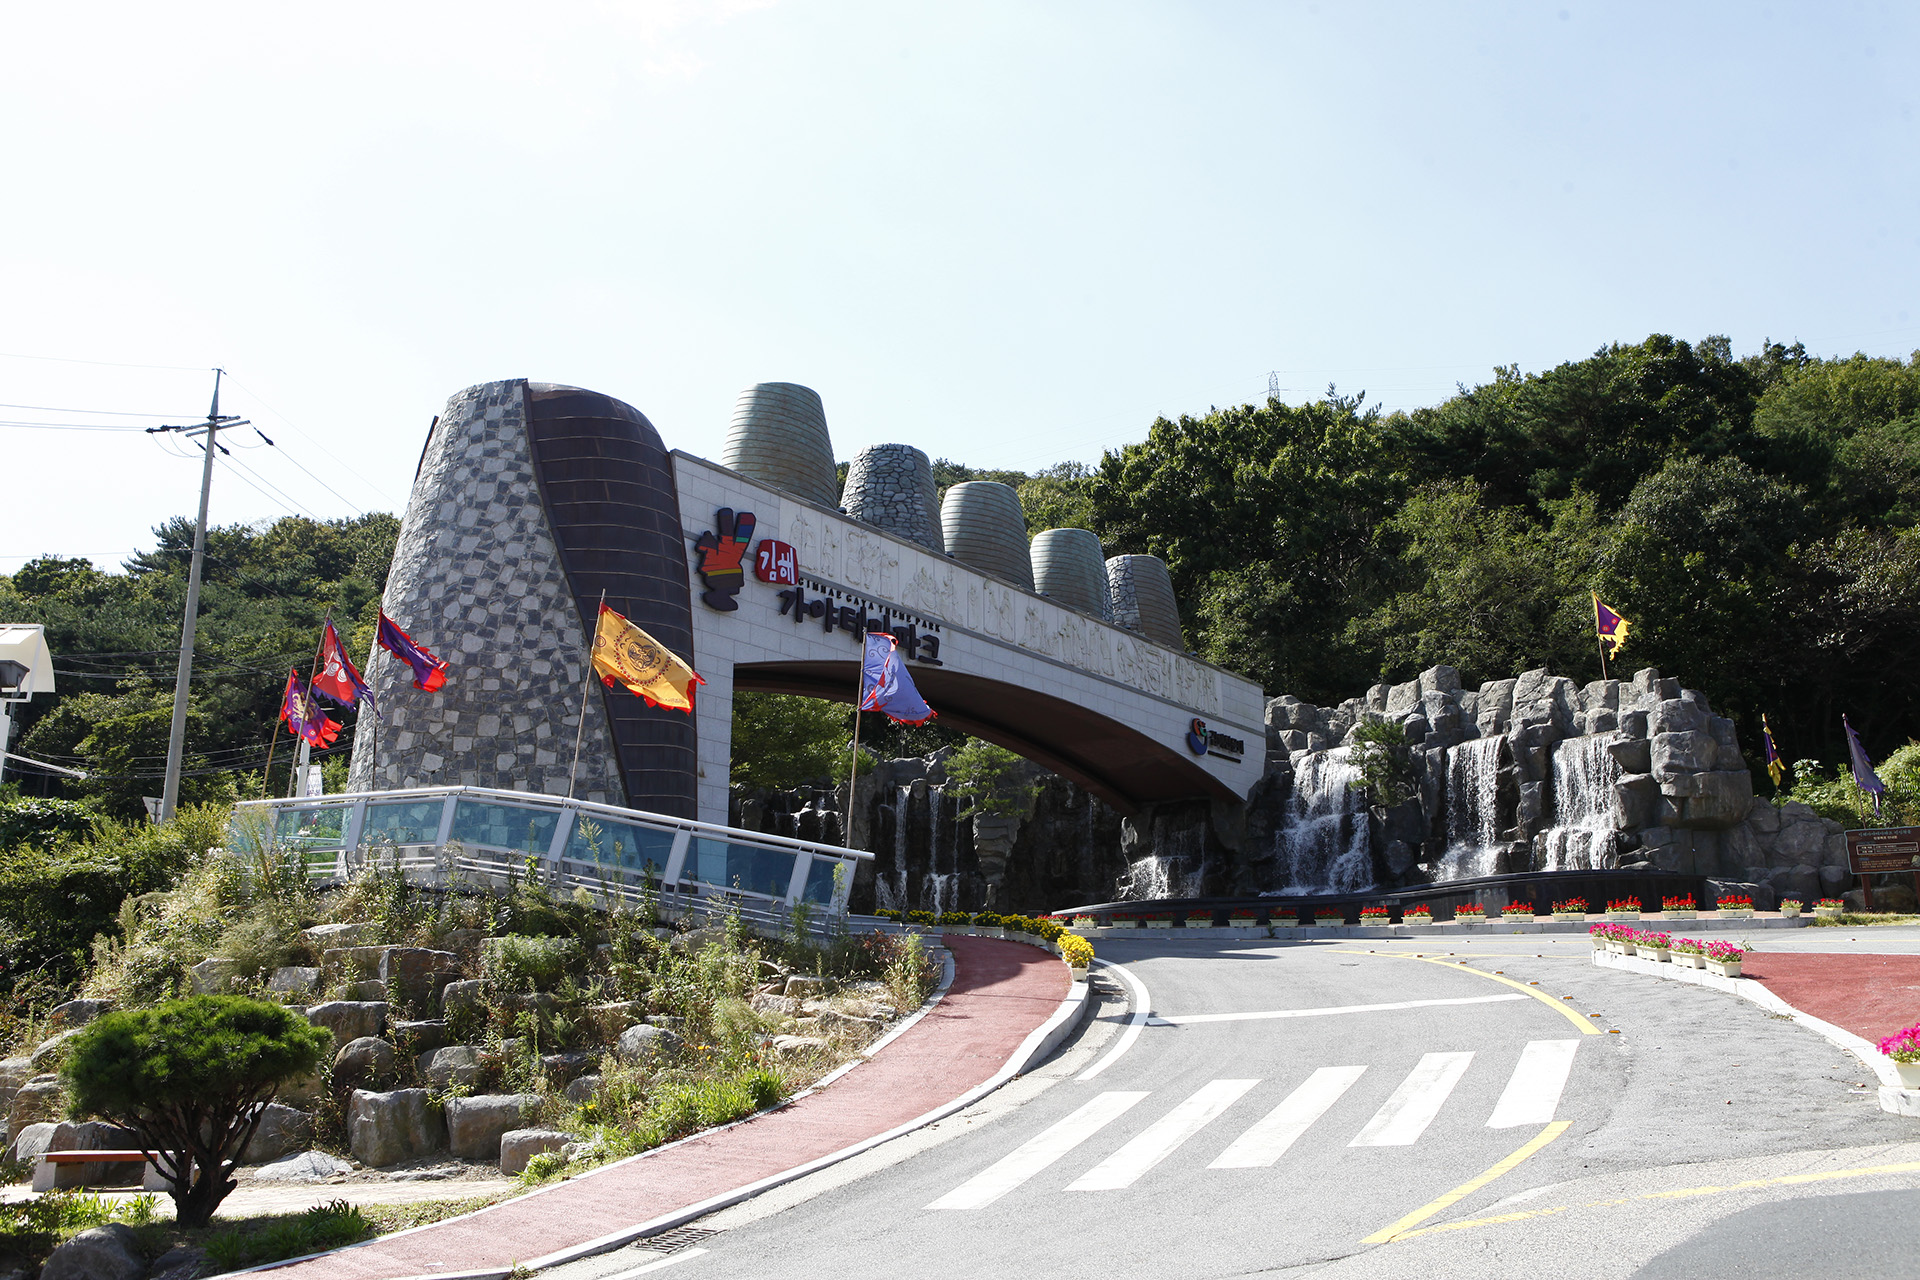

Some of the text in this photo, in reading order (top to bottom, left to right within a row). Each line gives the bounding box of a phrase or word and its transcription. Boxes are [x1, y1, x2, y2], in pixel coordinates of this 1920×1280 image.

[760, 541, 795, 585] 김해
[777, 587, 943, 666] 가야테마파크
[798, 577, 941, 633] GIMHAE GAYA THEME PARK
